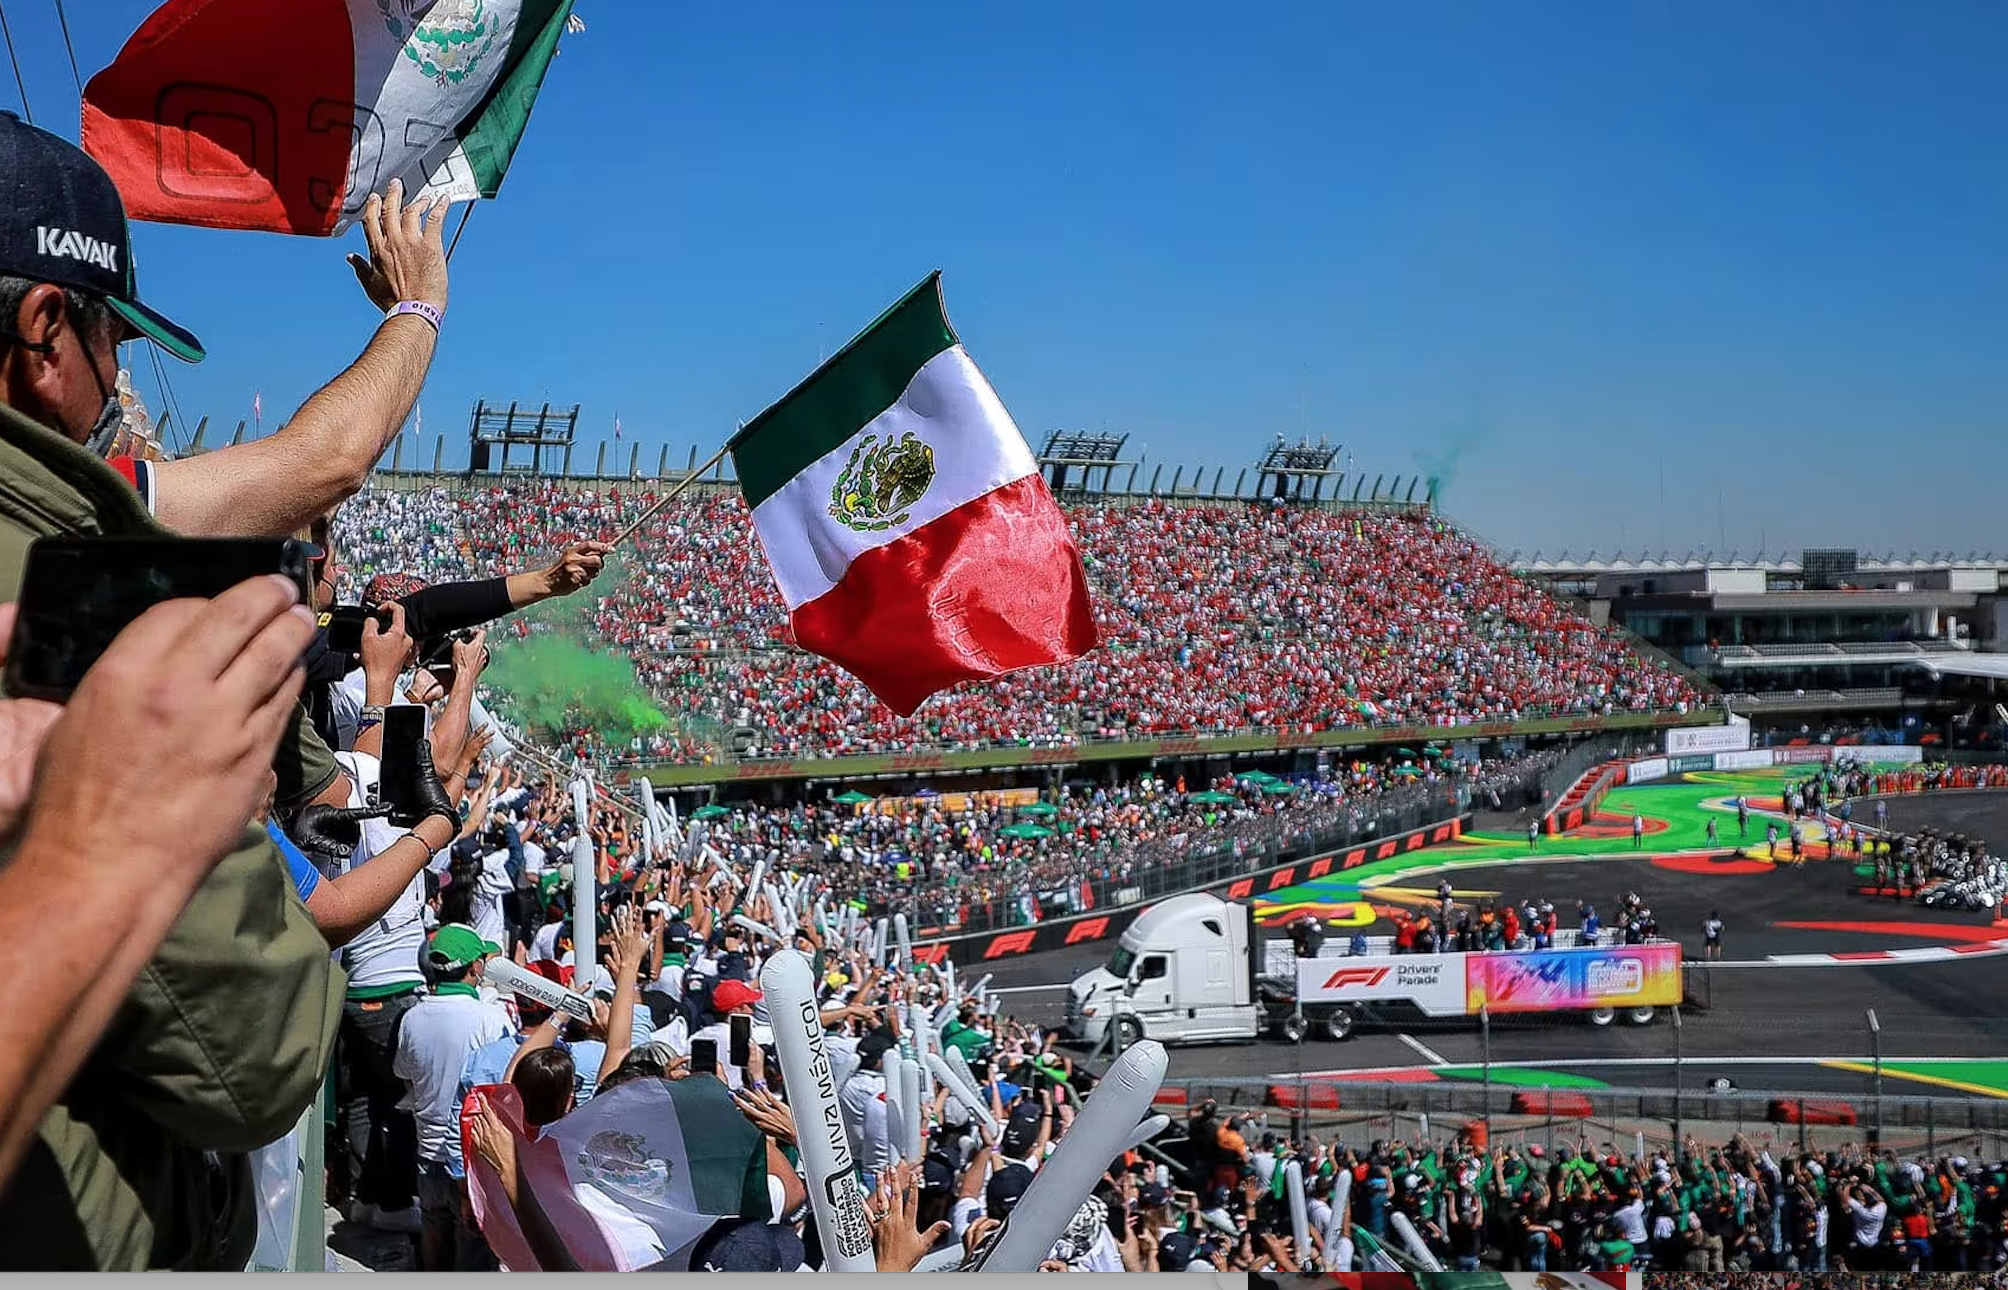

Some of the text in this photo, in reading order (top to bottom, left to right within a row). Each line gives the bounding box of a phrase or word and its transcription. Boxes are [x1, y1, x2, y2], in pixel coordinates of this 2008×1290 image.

[37, 226, 118, 272] KAVAK
[984, 930, 1037, 959] F1
[1065, 916, 1110, 945] F1
[1321, 966, 1392, 989] F1
[1398, 976, 1439, 986] Parade
[800, 999, 834, 1099] MÉXICO!
[839, 1202, 857, 1258] FORMULA
[840, 1178, 863, 1254] GRAN PREMIO
